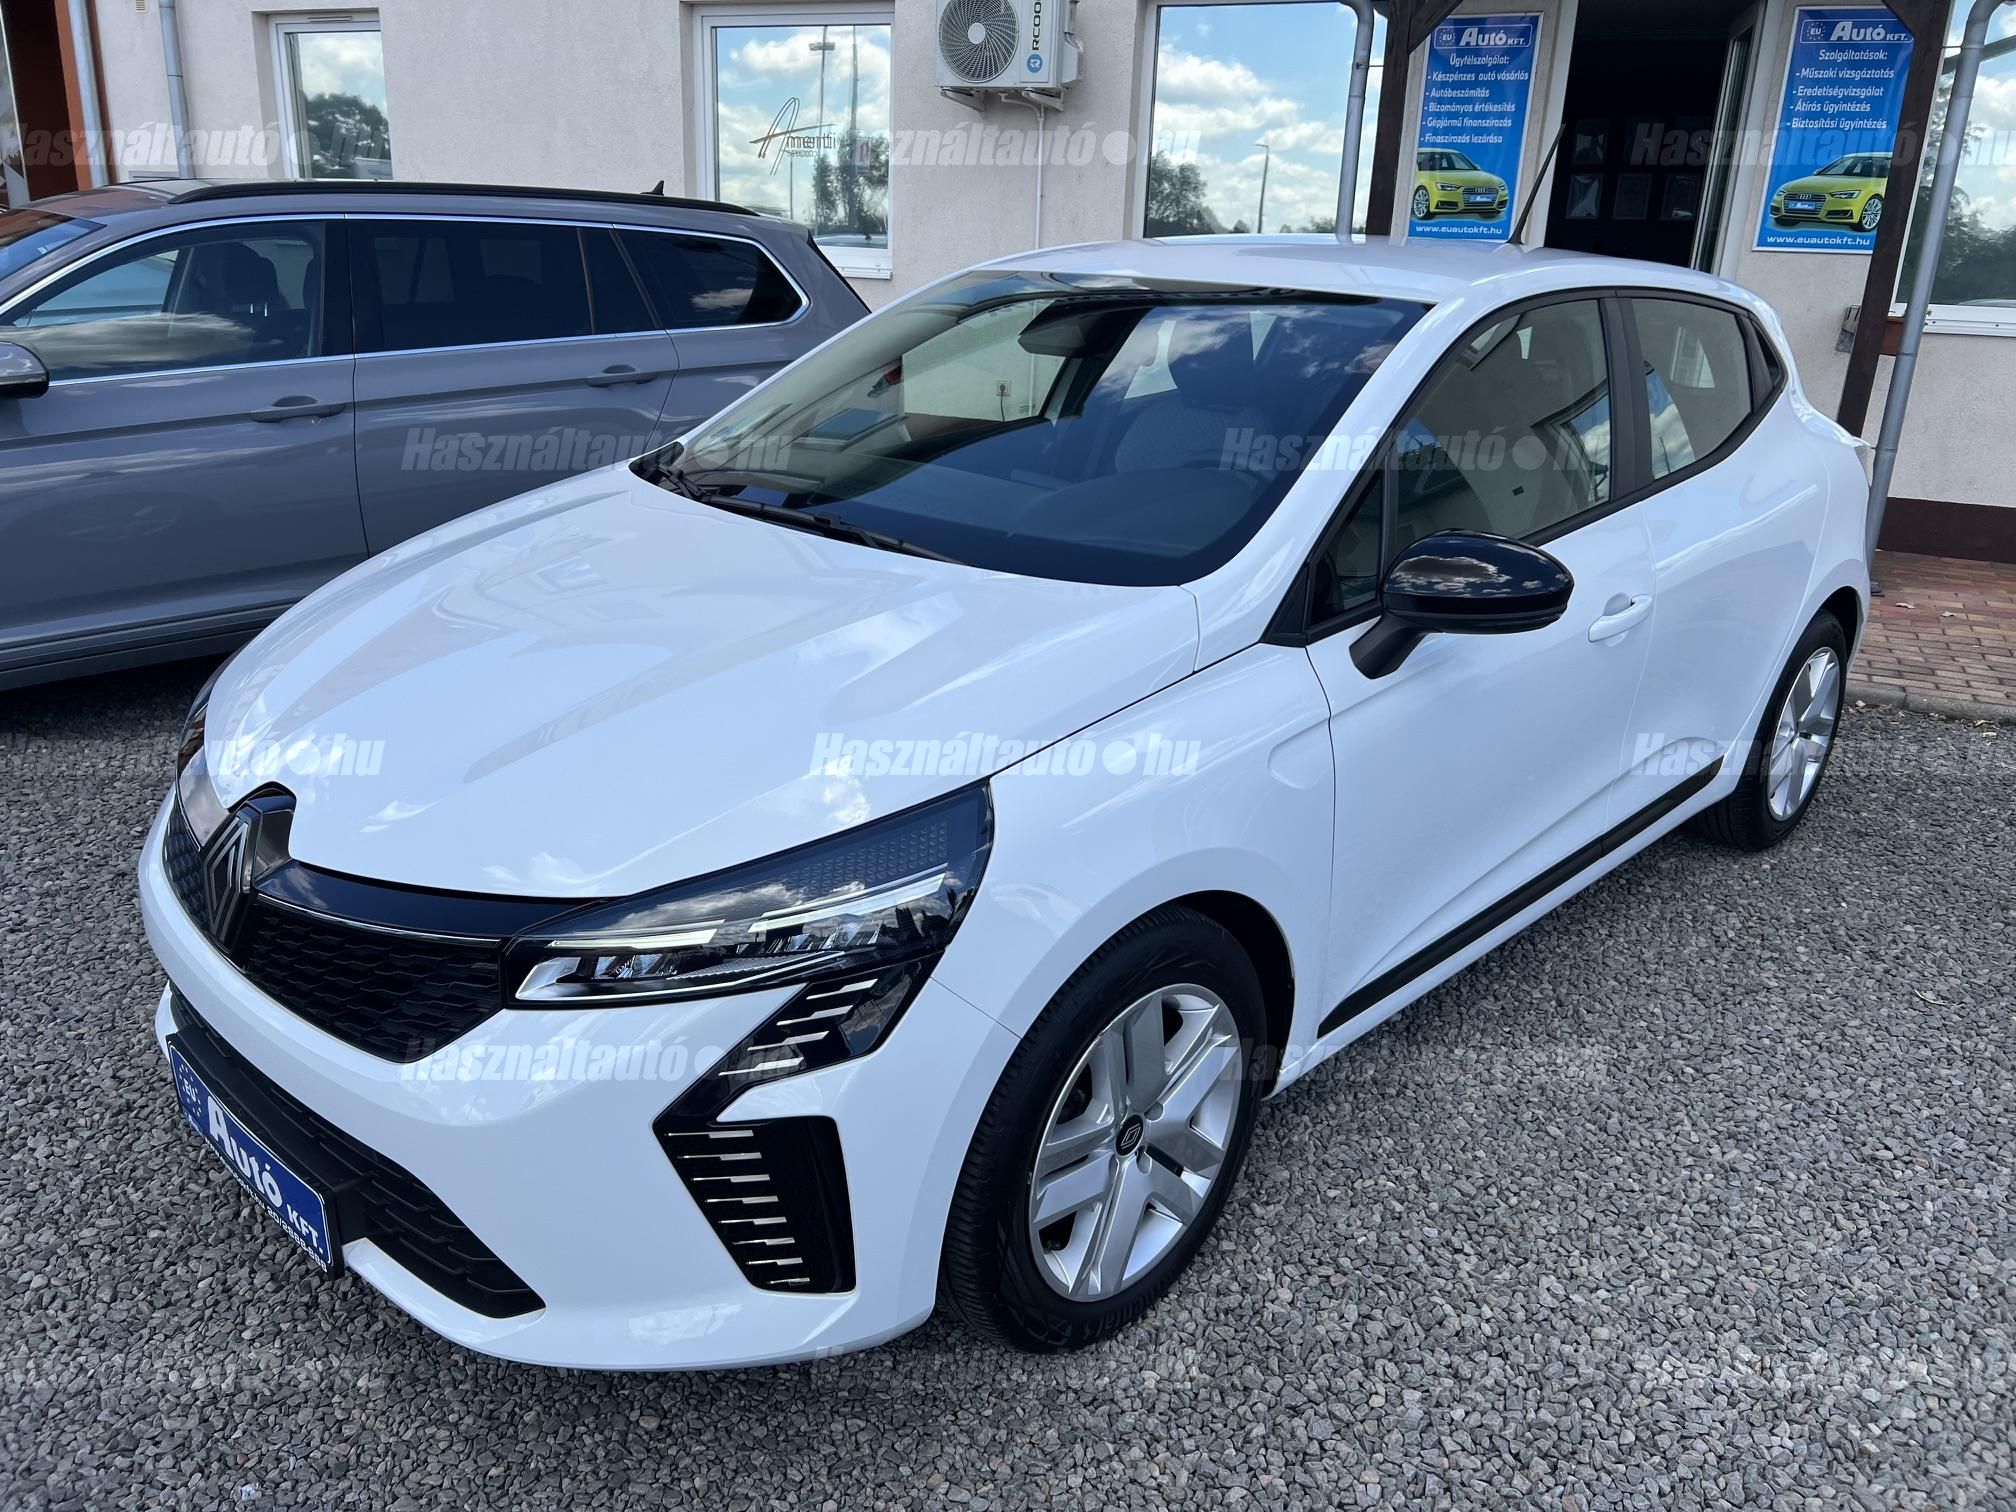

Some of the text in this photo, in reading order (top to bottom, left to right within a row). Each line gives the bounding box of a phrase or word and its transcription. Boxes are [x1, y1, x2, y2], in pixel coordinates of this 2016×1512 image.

[1459, 27, 1507, 46] Autó
[1507, 37, 1526, 46] KFT.
[1810, 21, 1908, 41] EU Autó KFT.
[1449, 52, 1510, 67] Ügyfélszolgálat:
[1818, 49, 1888, 62] Szolgáltatások:
[1432, 71, 1476, 82] Készpénzes
[1478, 71, 1496, 81] autó
[1800, 67, 1895, 81] Műszaki vizsgáztatás
[1797, 85, 1885, 98] Eredetiségvizsgálat
[1429, 102, 1516, 114] Bizományos értékesítés
[1795, 99, 1822, 112] Átírás
[1791, 117, 1838, 128] Biztosítási
[1416, 226, 1502, 235] www.euautokft.hu
[1767, 235, 1870, 245] www.euautokft.hu
[183, 1078, 197, 1102] EU
[207, 1095, 283, 1208] Autó
[286, 1203, 324, 1255] KFT.
